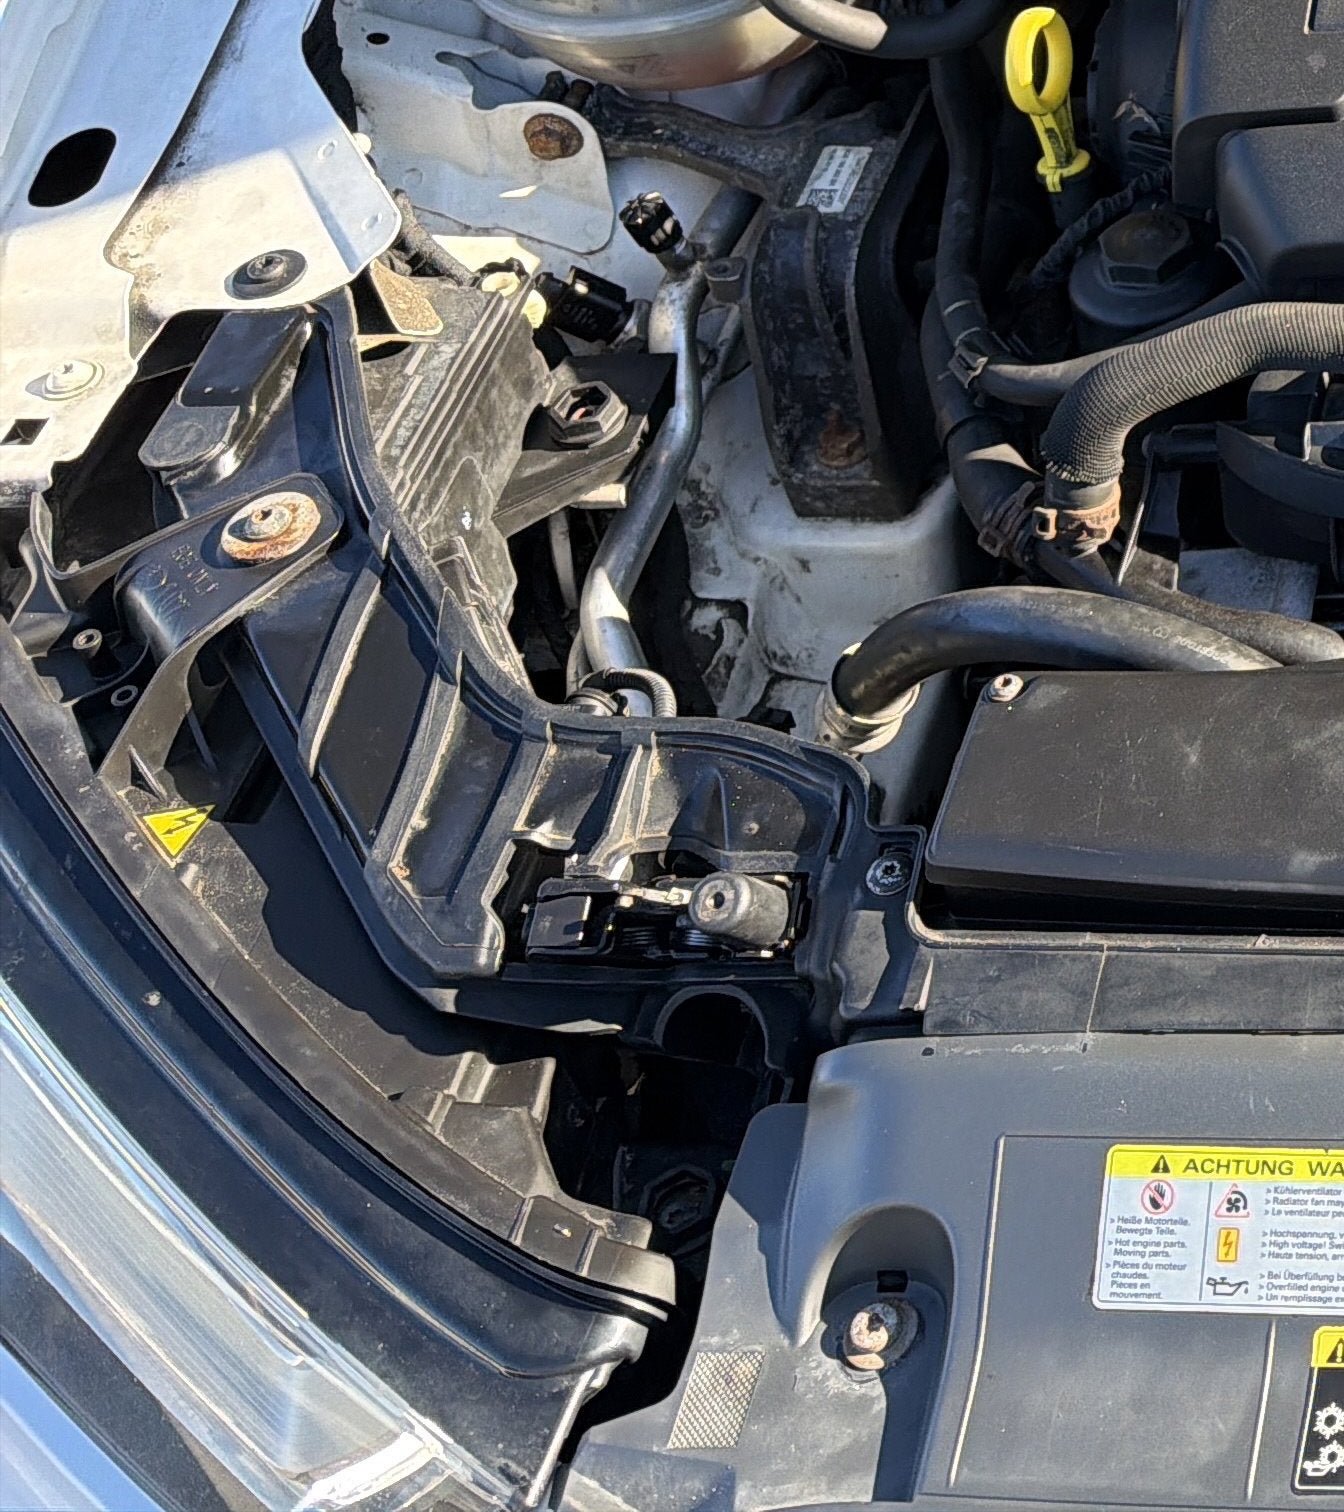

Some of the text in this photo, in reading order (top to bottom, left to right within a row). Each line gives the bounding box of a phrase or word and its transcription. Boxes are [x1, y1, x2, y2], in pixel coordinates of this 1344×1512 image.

[1183, 1158, 1294, 1176] ACHTUNG
[1274, 1186, 1341, 1196] Kühlerventilator
[1273, 1197, 1309, 1206] Radiator
[1311, 1198, 1325, 1206] fan
[1327, 1199, 1344, 1208] may
[1271, 1208, 1282, 1216] Le
[1284, 1208, 1329, 1217] ventilateur
[1117, 1216, 1191, 1226] Heiße Motorteile.
[1116, 1226, 1177, 1236] Bewegte Teile.
[1115, 1238, 1187, 1249] Hot engine parts.
[1269, 1240, 1289, 1250] High
[1113, 1248, 1146, 1258] Moving
[1268, 1251, 1293, 1259] Haute
[1142, 1261, 1153, 1269] du
[1111, 1271, 1149, 1279] chaudes.
[1267, 1271, 1281, 1280] Bei
[1266, 1282, 1308, 1291] Overfilled
[1310, 1284, 1339, 1293] engine
[1266, 1293, 1278, 1301] Un
[1280, 1294, 1332, 1304] remplissage
